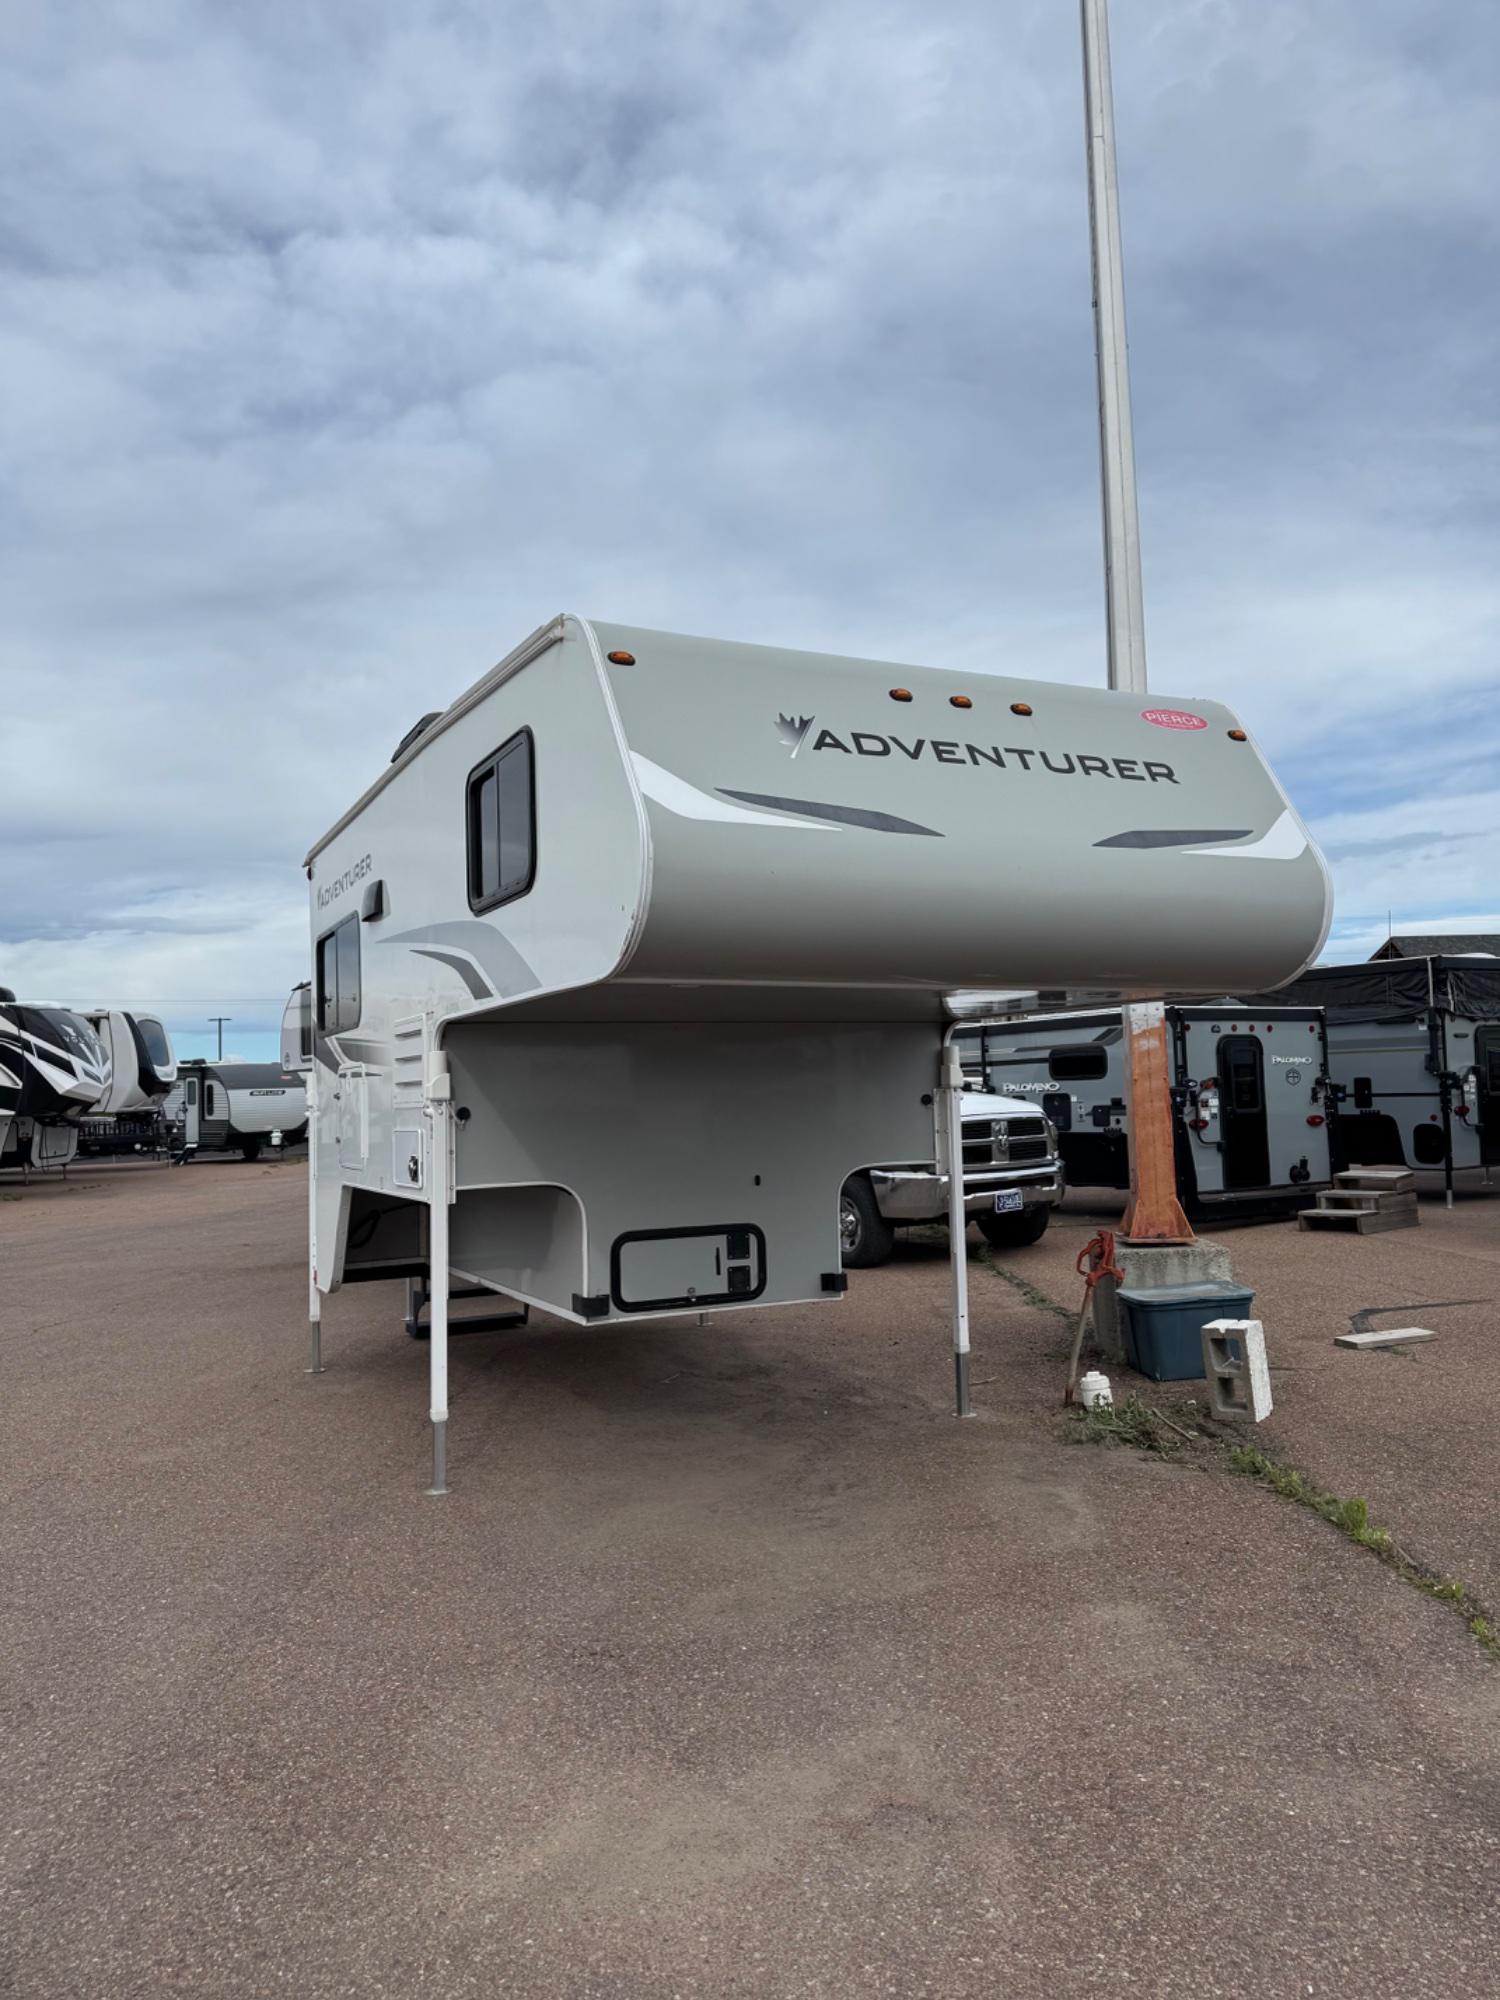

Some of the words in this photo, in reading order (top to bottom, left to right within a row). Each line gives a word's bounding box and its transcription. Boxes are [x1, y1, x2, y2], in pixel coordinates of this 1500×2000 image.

[812, 729, 1182, 785] ADVENTURER
[320, 853, 373, 908] ADVENTURER
[1002, 1081, 1060, 1094] PALOMINO
